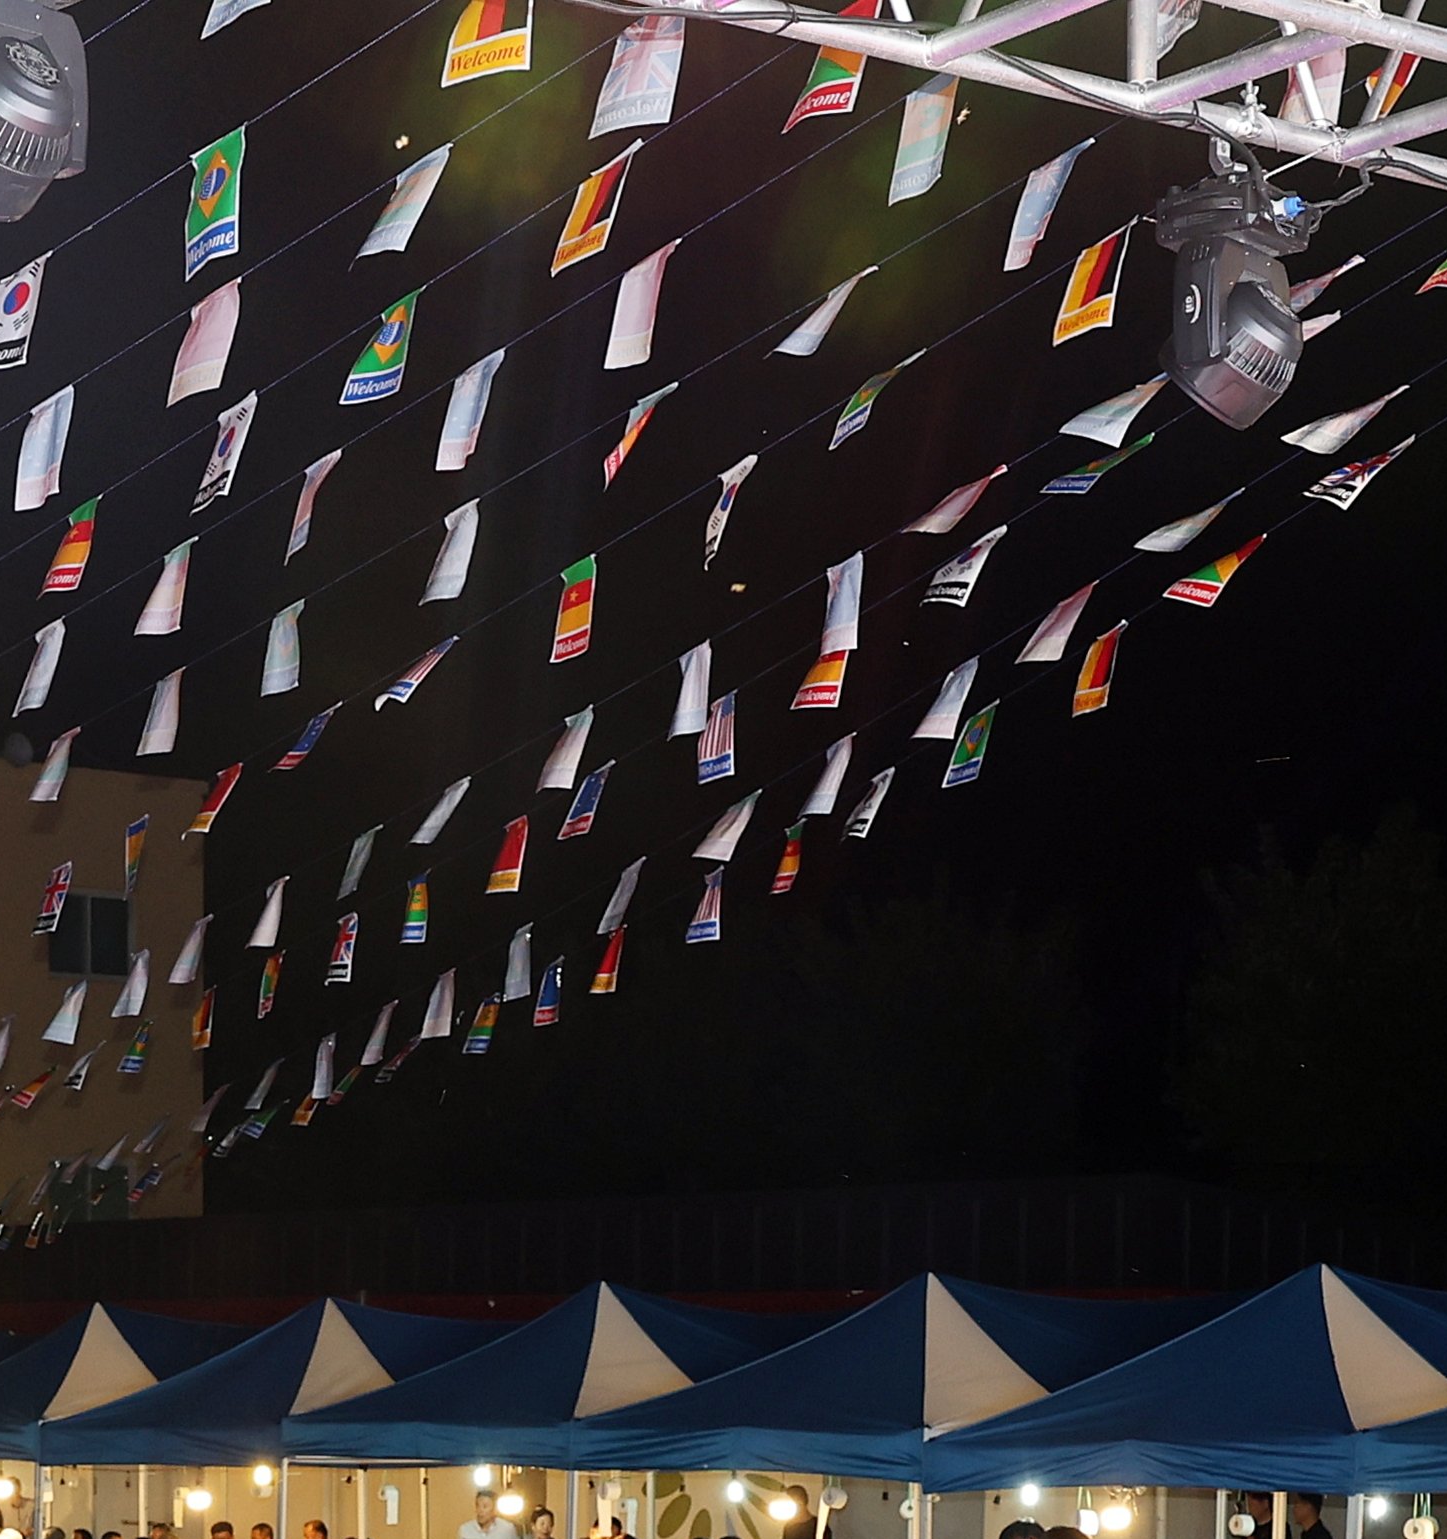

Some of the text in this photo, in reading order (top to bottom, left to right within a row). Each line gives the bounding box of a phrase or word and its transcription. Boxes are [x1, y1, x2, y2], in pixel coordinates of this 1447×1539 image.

[451, 48, 525, 75] Welcome
[188, 231, 235, 264] Welcome
[347, 377, 400, 398] Welcome
